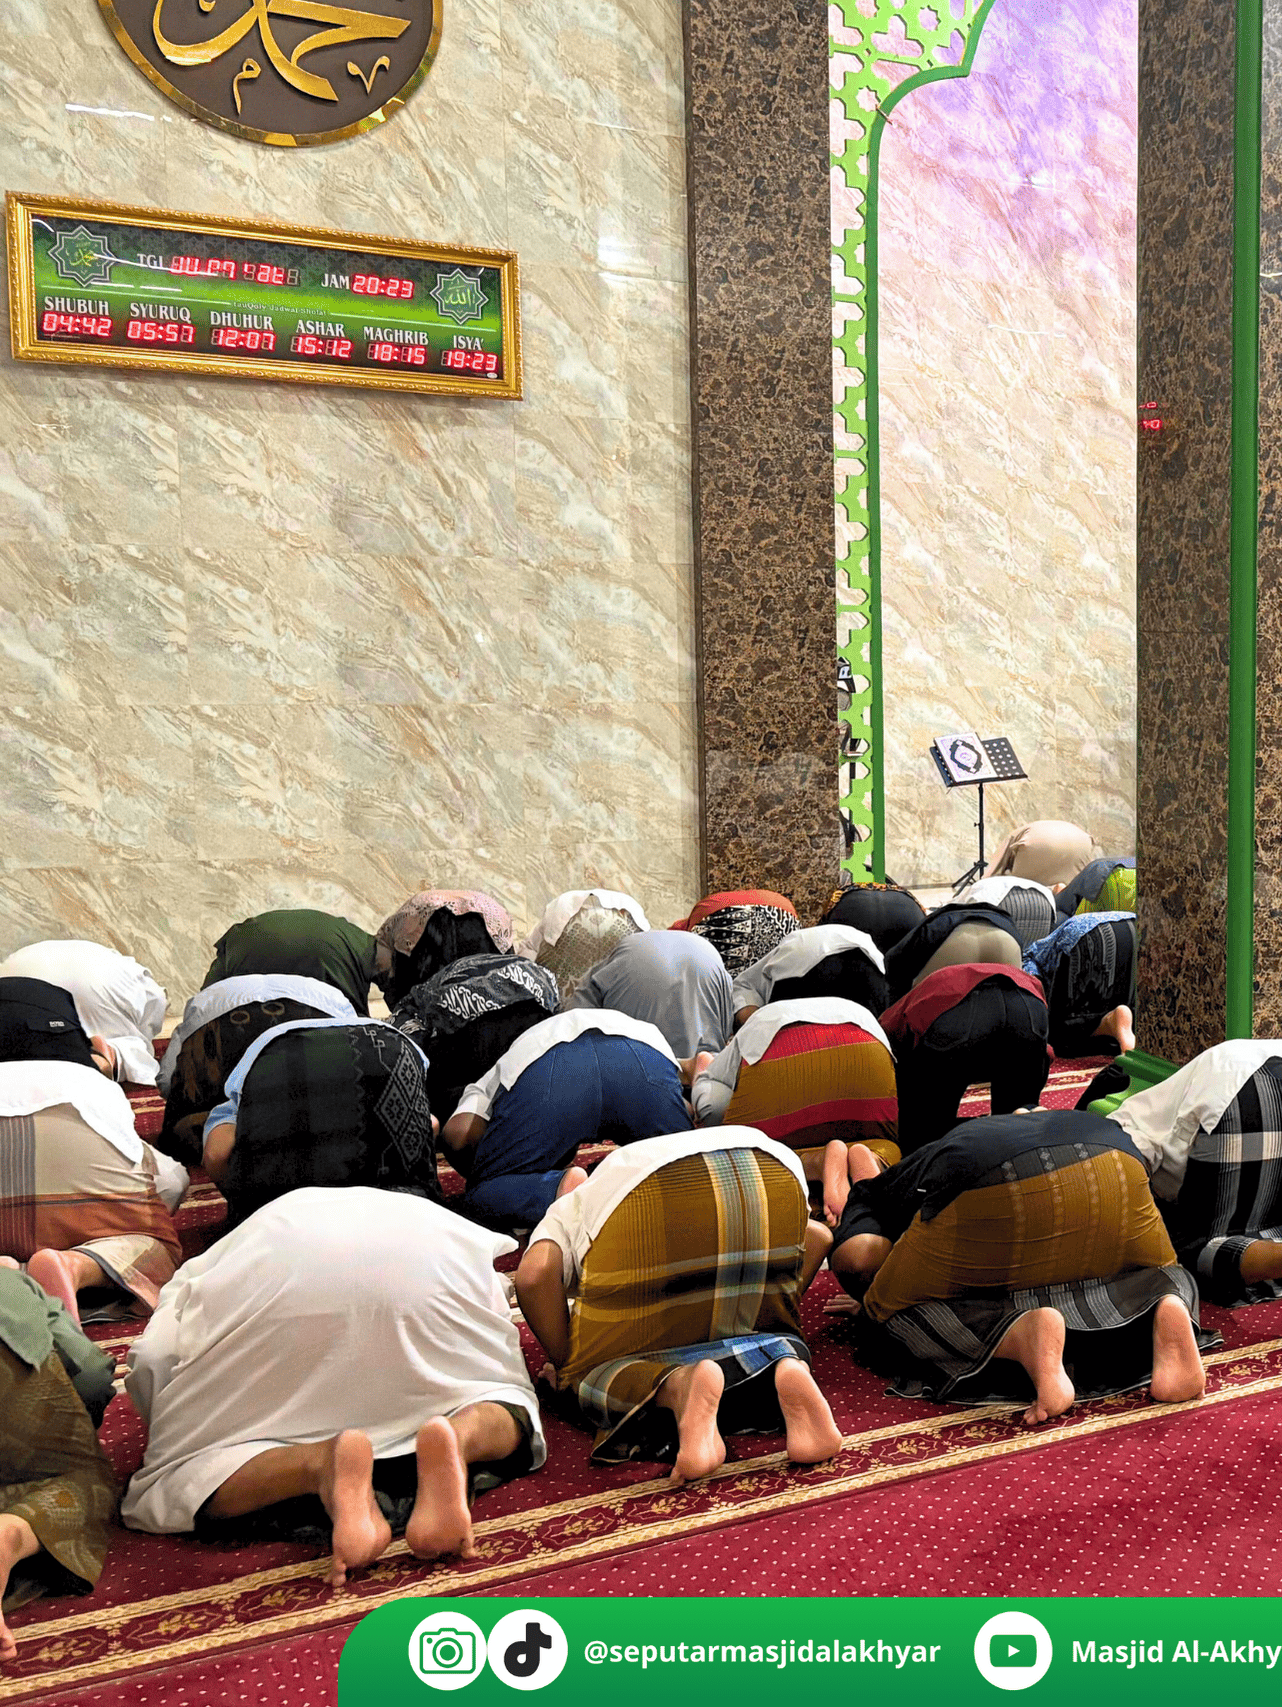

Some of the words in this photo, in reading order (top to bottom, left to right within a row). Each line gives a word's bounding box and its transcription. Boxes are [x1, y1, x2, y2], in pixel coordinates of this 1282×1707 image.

[321, 273, 350, 290] JAM
[352, 275, 414, 299] 20:23
[43, 313, 112, 337] 04:42
[127, 321, 194, 343] 05:57
[212, 329, 275, 351] 12:07
[295, 335, 352, 358] 15:12
[371, 344, 426, 365] 18:15
[445, 351, 498, 371] 19:23
[44, 296, 110, 316] SHUBUH
[130, 302, 192, 324] SYURUQ
[210, 311, 274, 331] DHUHUR
[296, 319, 346, 338] ASHAR
[363, 326, 429, 346] MAGHRIB
